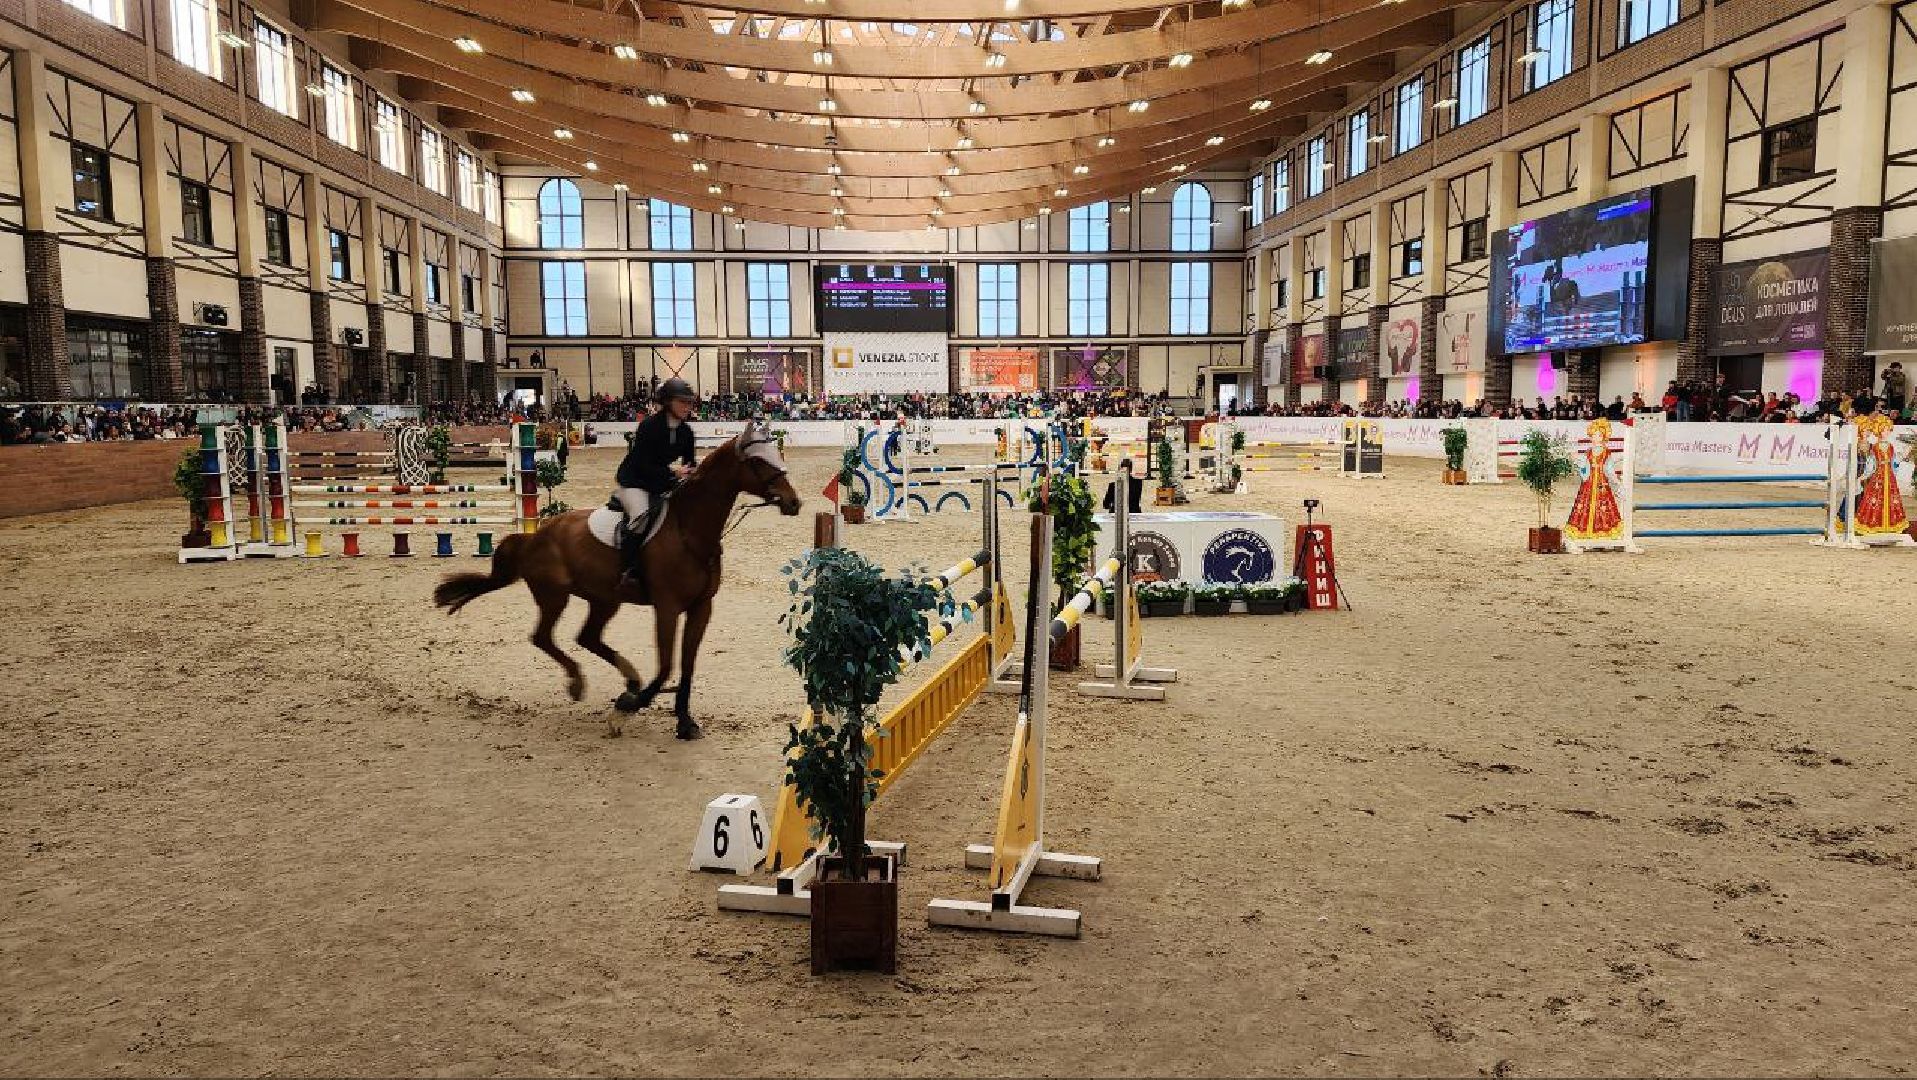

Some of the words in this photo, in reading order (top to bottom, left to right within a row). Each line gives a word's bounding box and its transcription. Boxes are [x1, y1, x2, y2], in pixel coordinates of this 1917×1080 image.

[1757, 277, 1818, 300] КОСМЕТИКА
[1721, 306, 1745, 323] DEUS
[1754, 303, 1774, 319] ДЛЯ
[1774, 296, 1817, 317] ЛОШАДЕЙ
[859, 352, 907, 363] VENEZIA
[908, 352, 940, 363] STONE
[1692, 440, 1733, 454] Masters
[1798, 443, 1849, 459] Maxia
[1312, 530, 1331, 607] ФИНИШ
[713, 815, 730, 858] 6
[750, 809, 763, 850] 6
